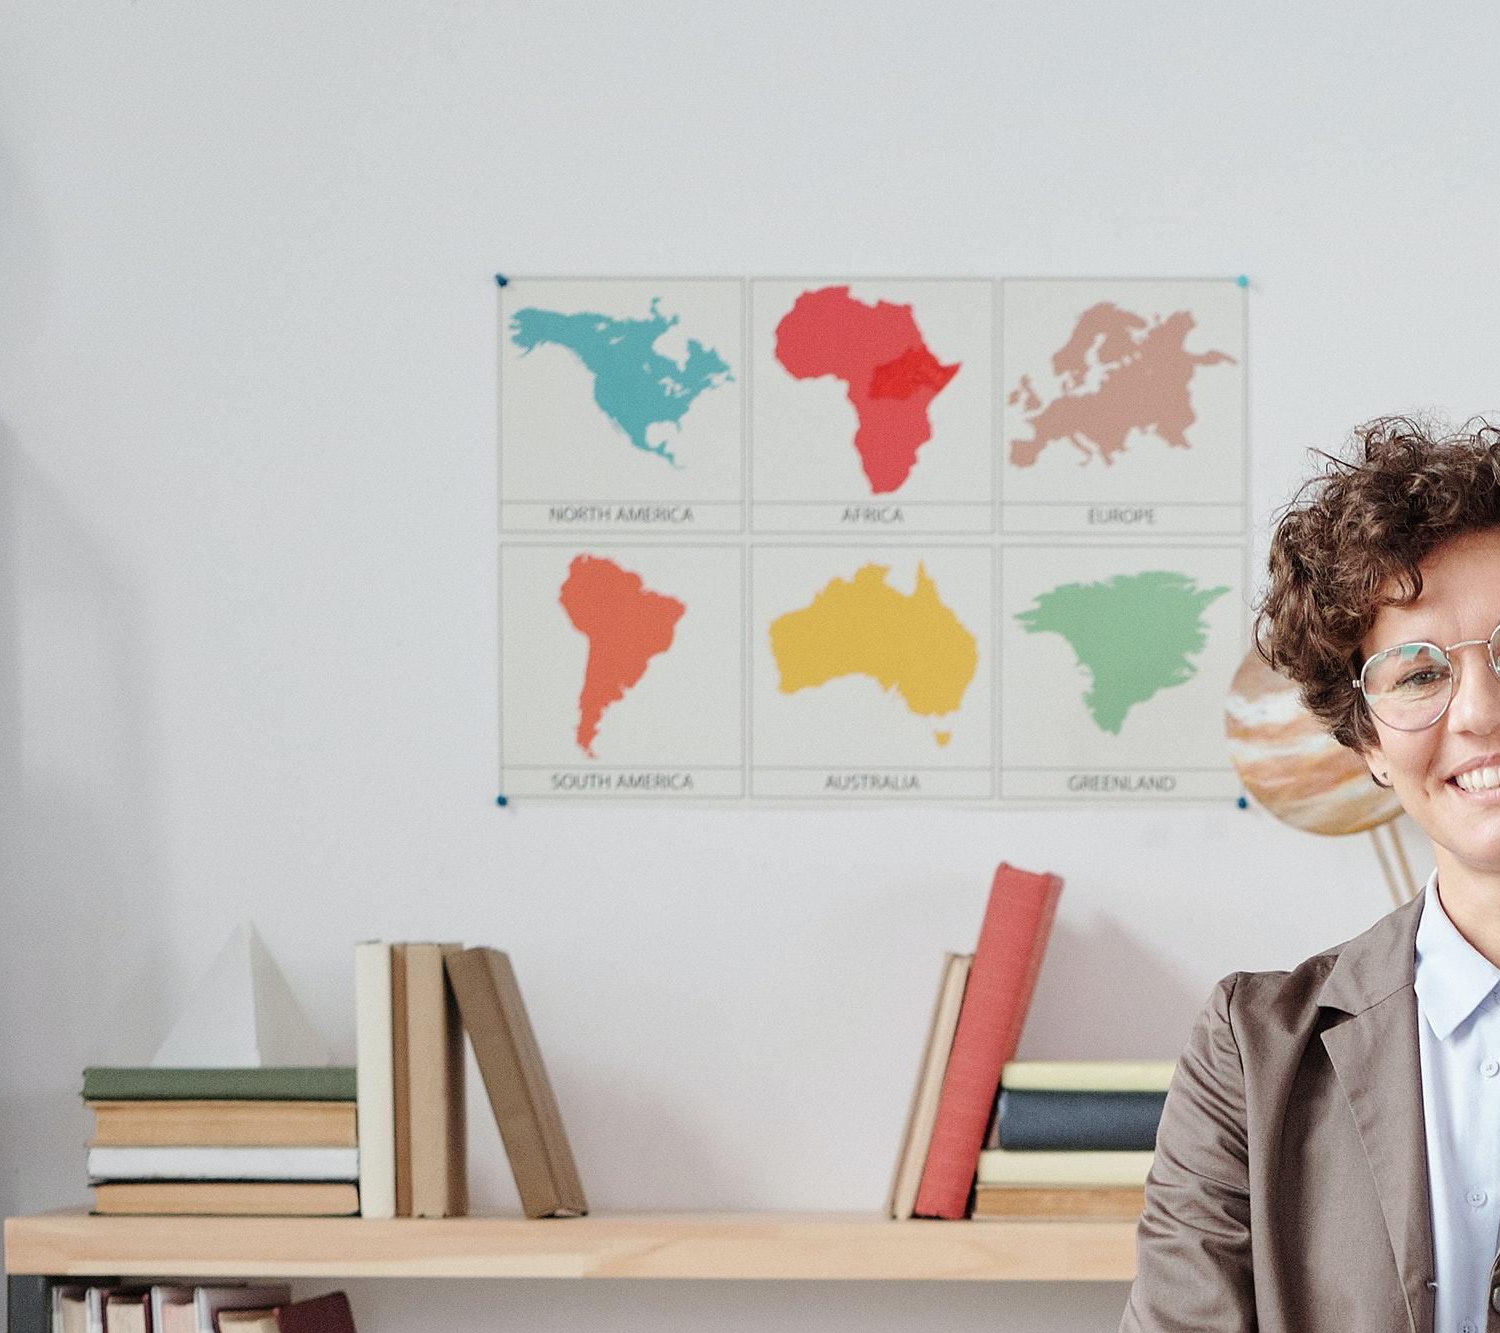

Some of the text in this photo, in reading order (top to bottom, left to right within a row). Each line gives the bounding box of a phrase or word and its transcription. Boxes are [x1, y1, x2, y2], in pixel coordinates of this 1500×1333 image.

[548, 506, 695, 523] NORTH AMERICA
[840, 506, 904, 524] AFRICA
[1086, 507, 1156, 525] EUROPE
[550, 773, 694, 790] SOUTH AMERICA
[824, 773, 921, 791] AUSTRALIA
[1066, 774, 1177, 792] GREENLAND
